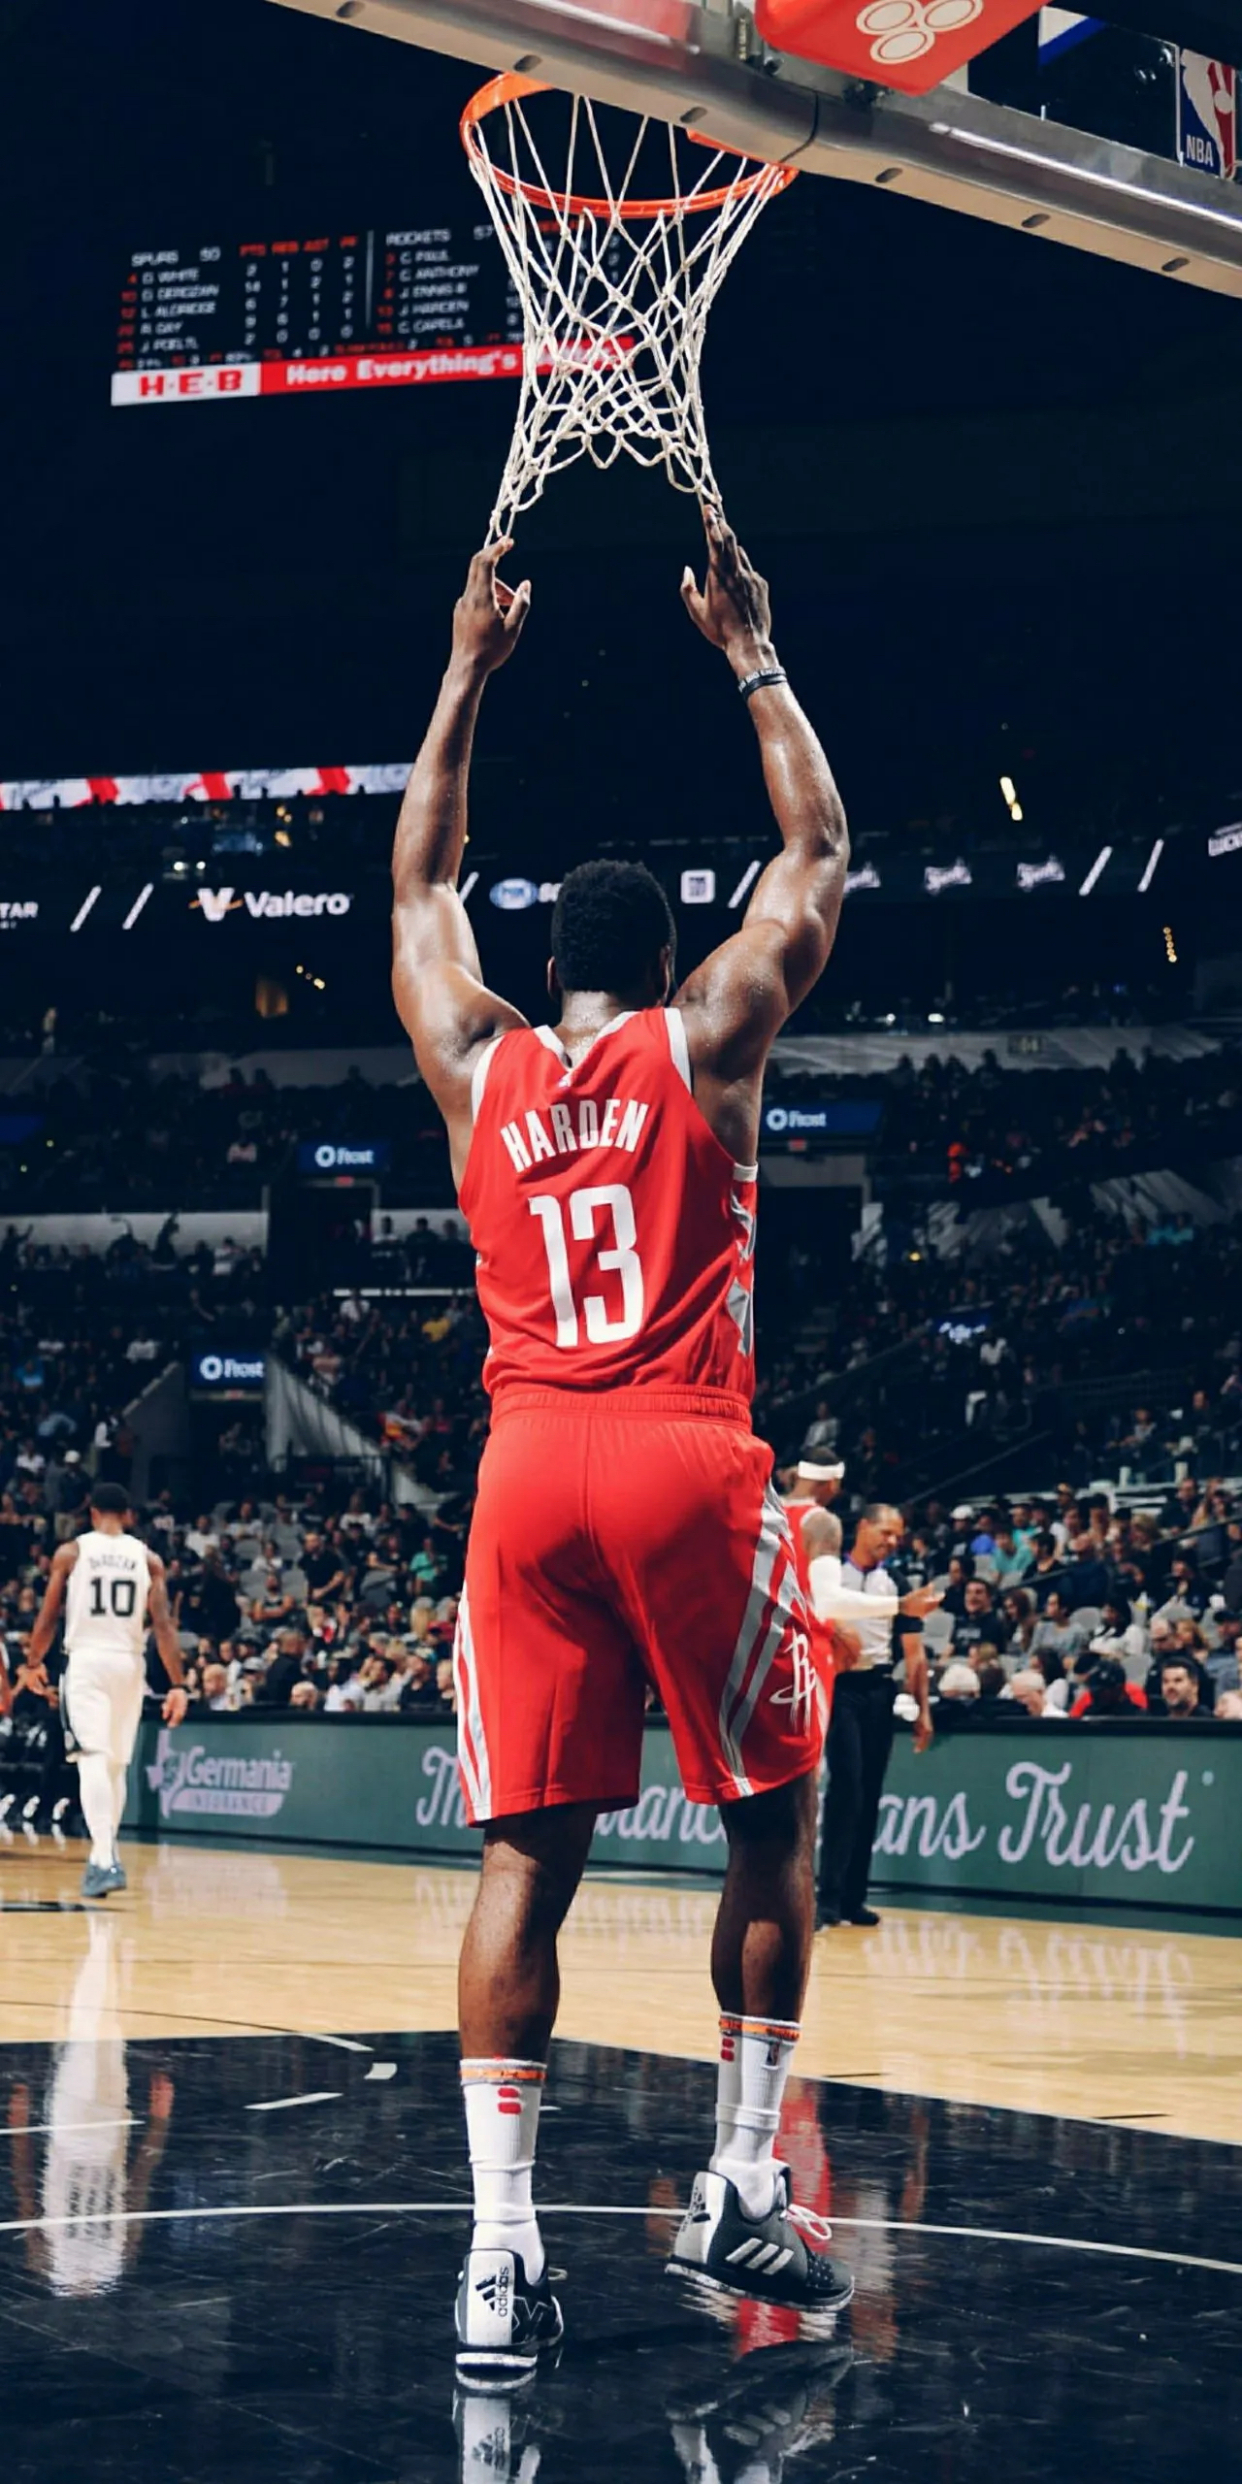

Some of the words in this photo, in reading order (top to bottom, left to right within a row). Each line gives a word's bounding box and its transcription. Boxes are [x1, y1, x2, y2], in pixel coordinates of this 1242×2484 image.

[1186, 133, 1214, 168] NBA
[385, 228, 451, 246] ROCKETS
[131, 250, 179, 267] SPURS
[412, 300, 470, 315] HARDEN
[413, 317, 466, 333] CAPELA
[286, 363, 347, 386] Here
[357, 350, 517, 381] Everything's
[244, 889, 351, 918] Valero
[500, 1098, 650, 1173] HARDEN
[527, 1183, 645, 1348] 13
[90, 1576, 137, 1618] 10
[187, 1745, 293, 1791] Germania
[416, 1745, 467, 1829] Th
[998, 1760, 1195, 1872] Trust
[498, 2266, 510, 2317] adidas
